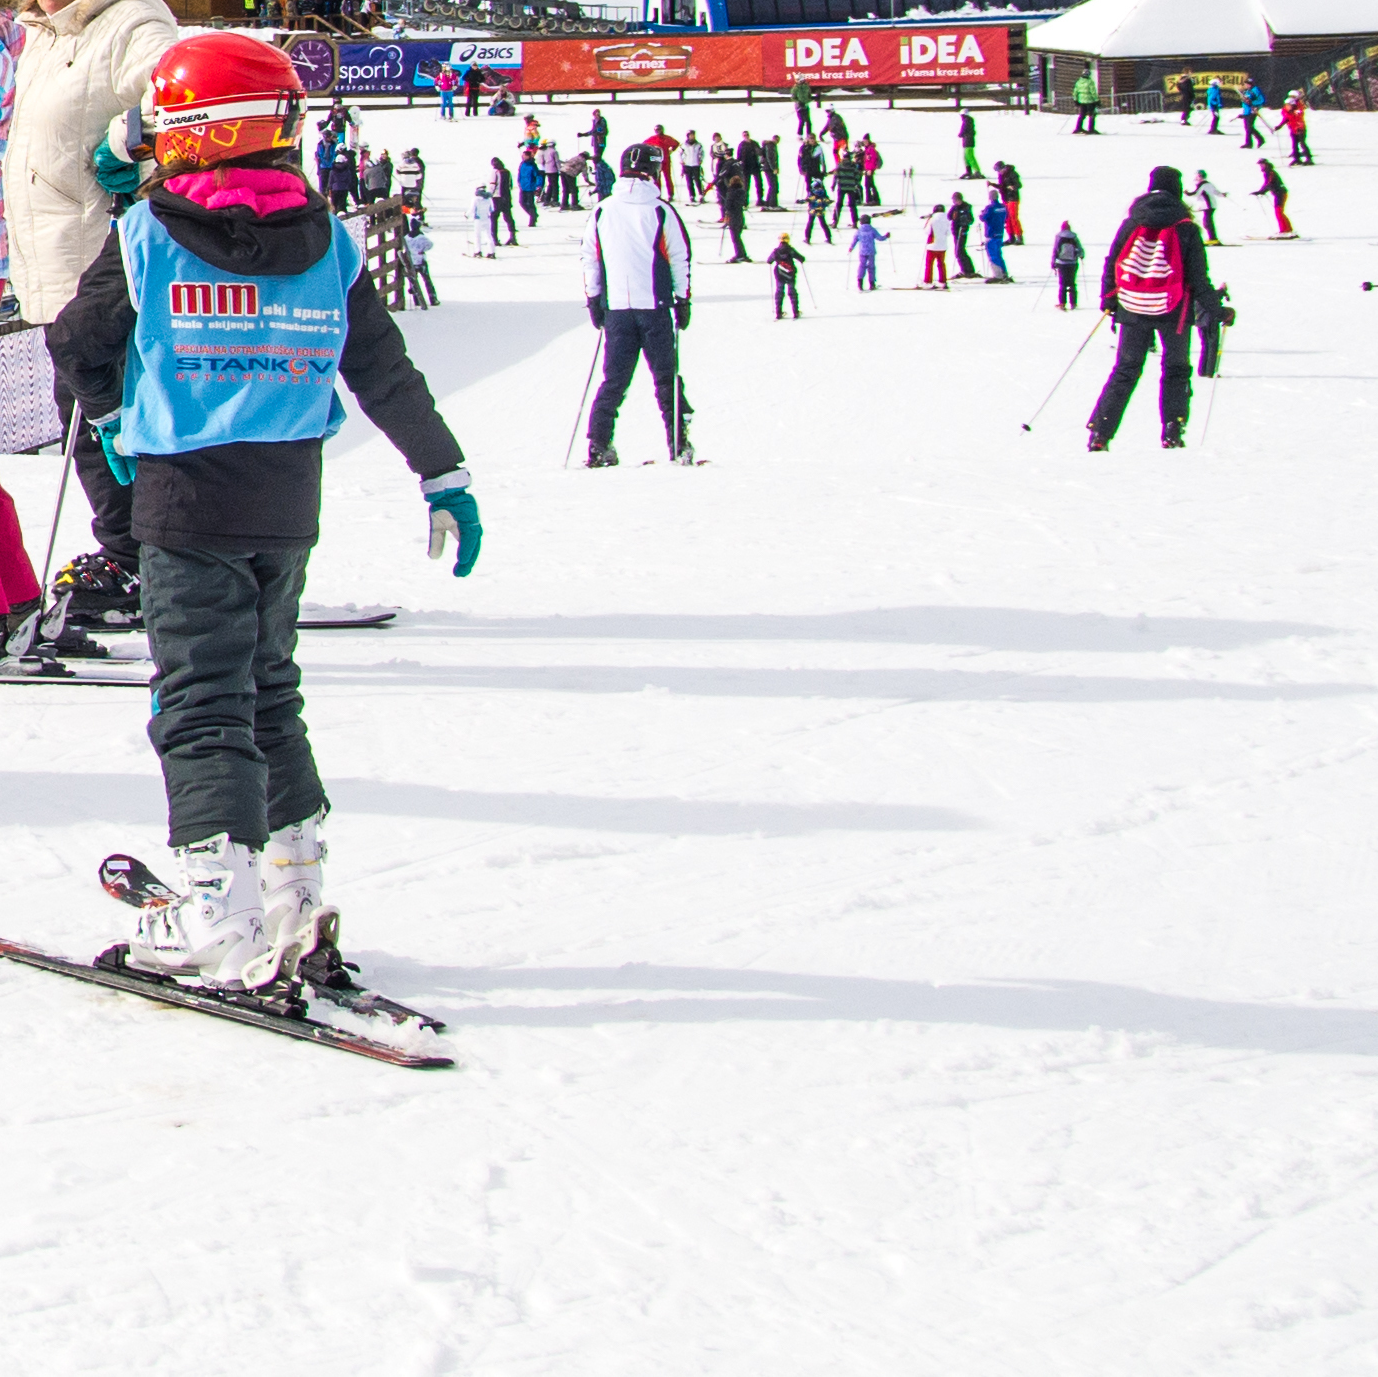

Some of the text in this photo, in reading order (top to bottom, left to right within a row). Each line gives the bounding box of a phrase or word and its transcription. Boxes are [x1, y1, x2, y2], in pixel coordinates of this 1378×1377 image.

[477, 46, 514, 60] asics
[339, 61, 389, 84] sport
[163, 113, 210, 126] CARRERA
[262, 303, 287, 316] ski
[293, 307, 341, 321] sport
[176, 357, 334, 375] STANKOV
